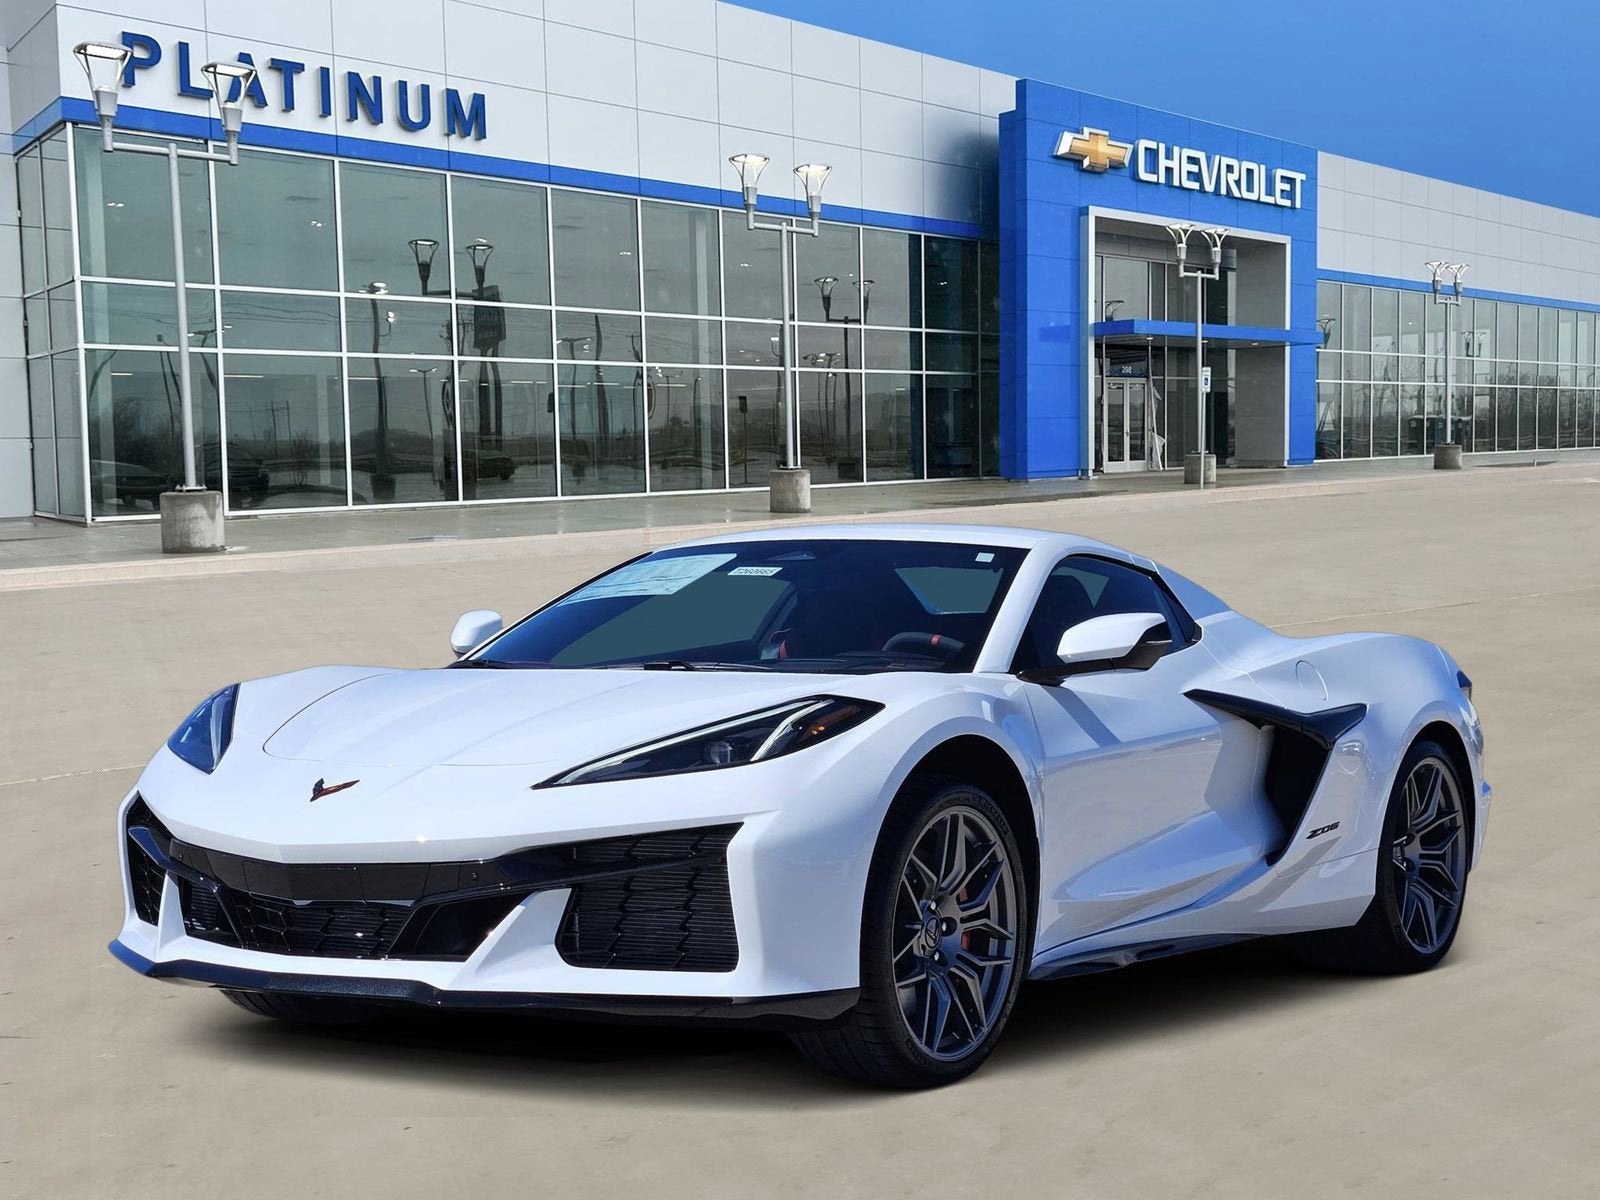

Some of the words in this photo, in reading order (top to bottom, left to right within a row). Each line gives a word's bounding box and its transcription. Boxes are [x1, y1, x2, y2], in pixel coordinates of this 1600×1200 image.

[121, 31, 487, 140] PLATINUM
[1136, 138, 1306, 209] CHEVROLET
[1305, 821, 1341, 840] Z06
